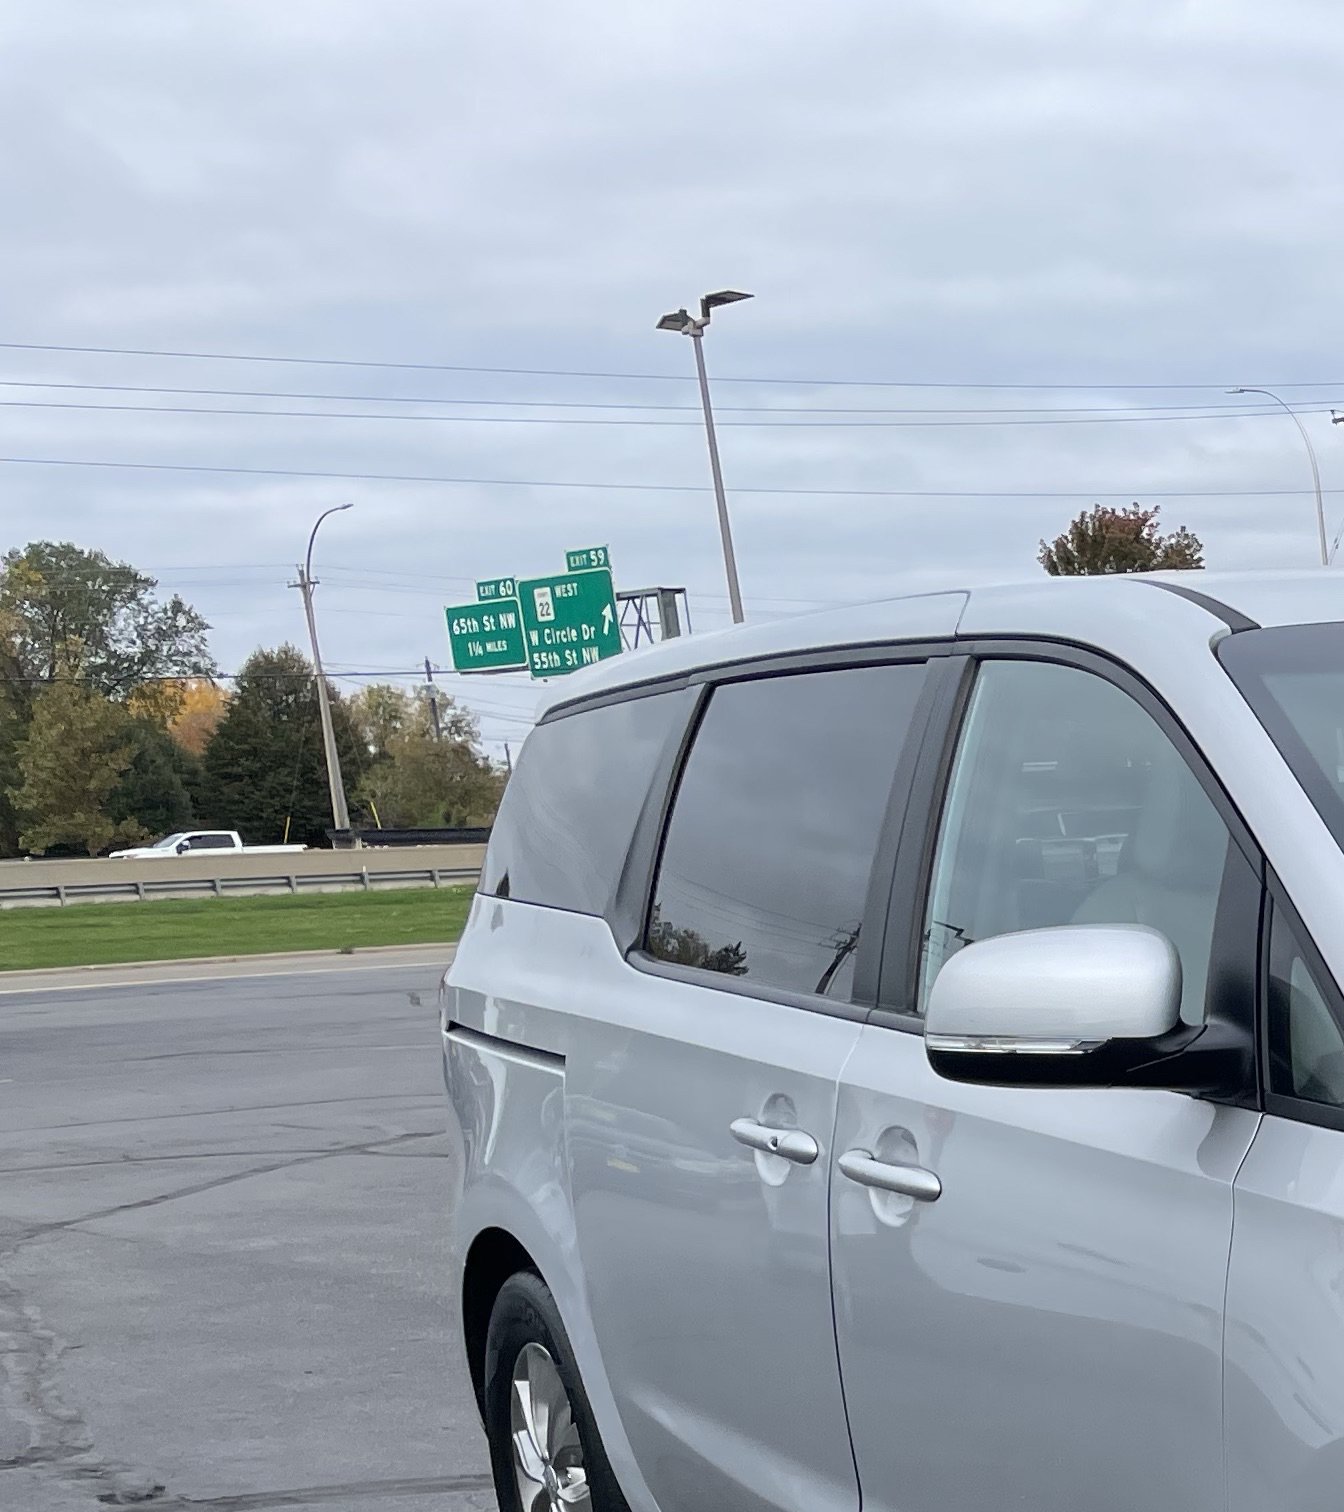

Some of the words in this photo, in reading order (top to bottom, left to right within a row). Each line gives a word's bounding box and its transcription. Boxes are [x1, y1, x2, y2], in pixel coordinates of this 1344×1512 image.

[569, 553, 588, 568] EXIT
[590, 549, 605, 567] 59
[480, 585, 496, 597] EXIT
[499, 580, 513, 597] 60
[554, 582, 578, 598] WEST
[538, 601, 552, 617] 22
[453, 618, 480, 635] 65th
[482, 615, 496, 632] St
[499, 612, 516, 630] NW
[529, 629, 539, 647] W
[543, 626, 578, 645] Circle
[581, 623, 596, 641] Dr
[486, 640, 508, 653] MILES
[532, 651, 561, 670] 55th
[564, 649, 578, 666] St
[582, 646, 600, 664] NW
